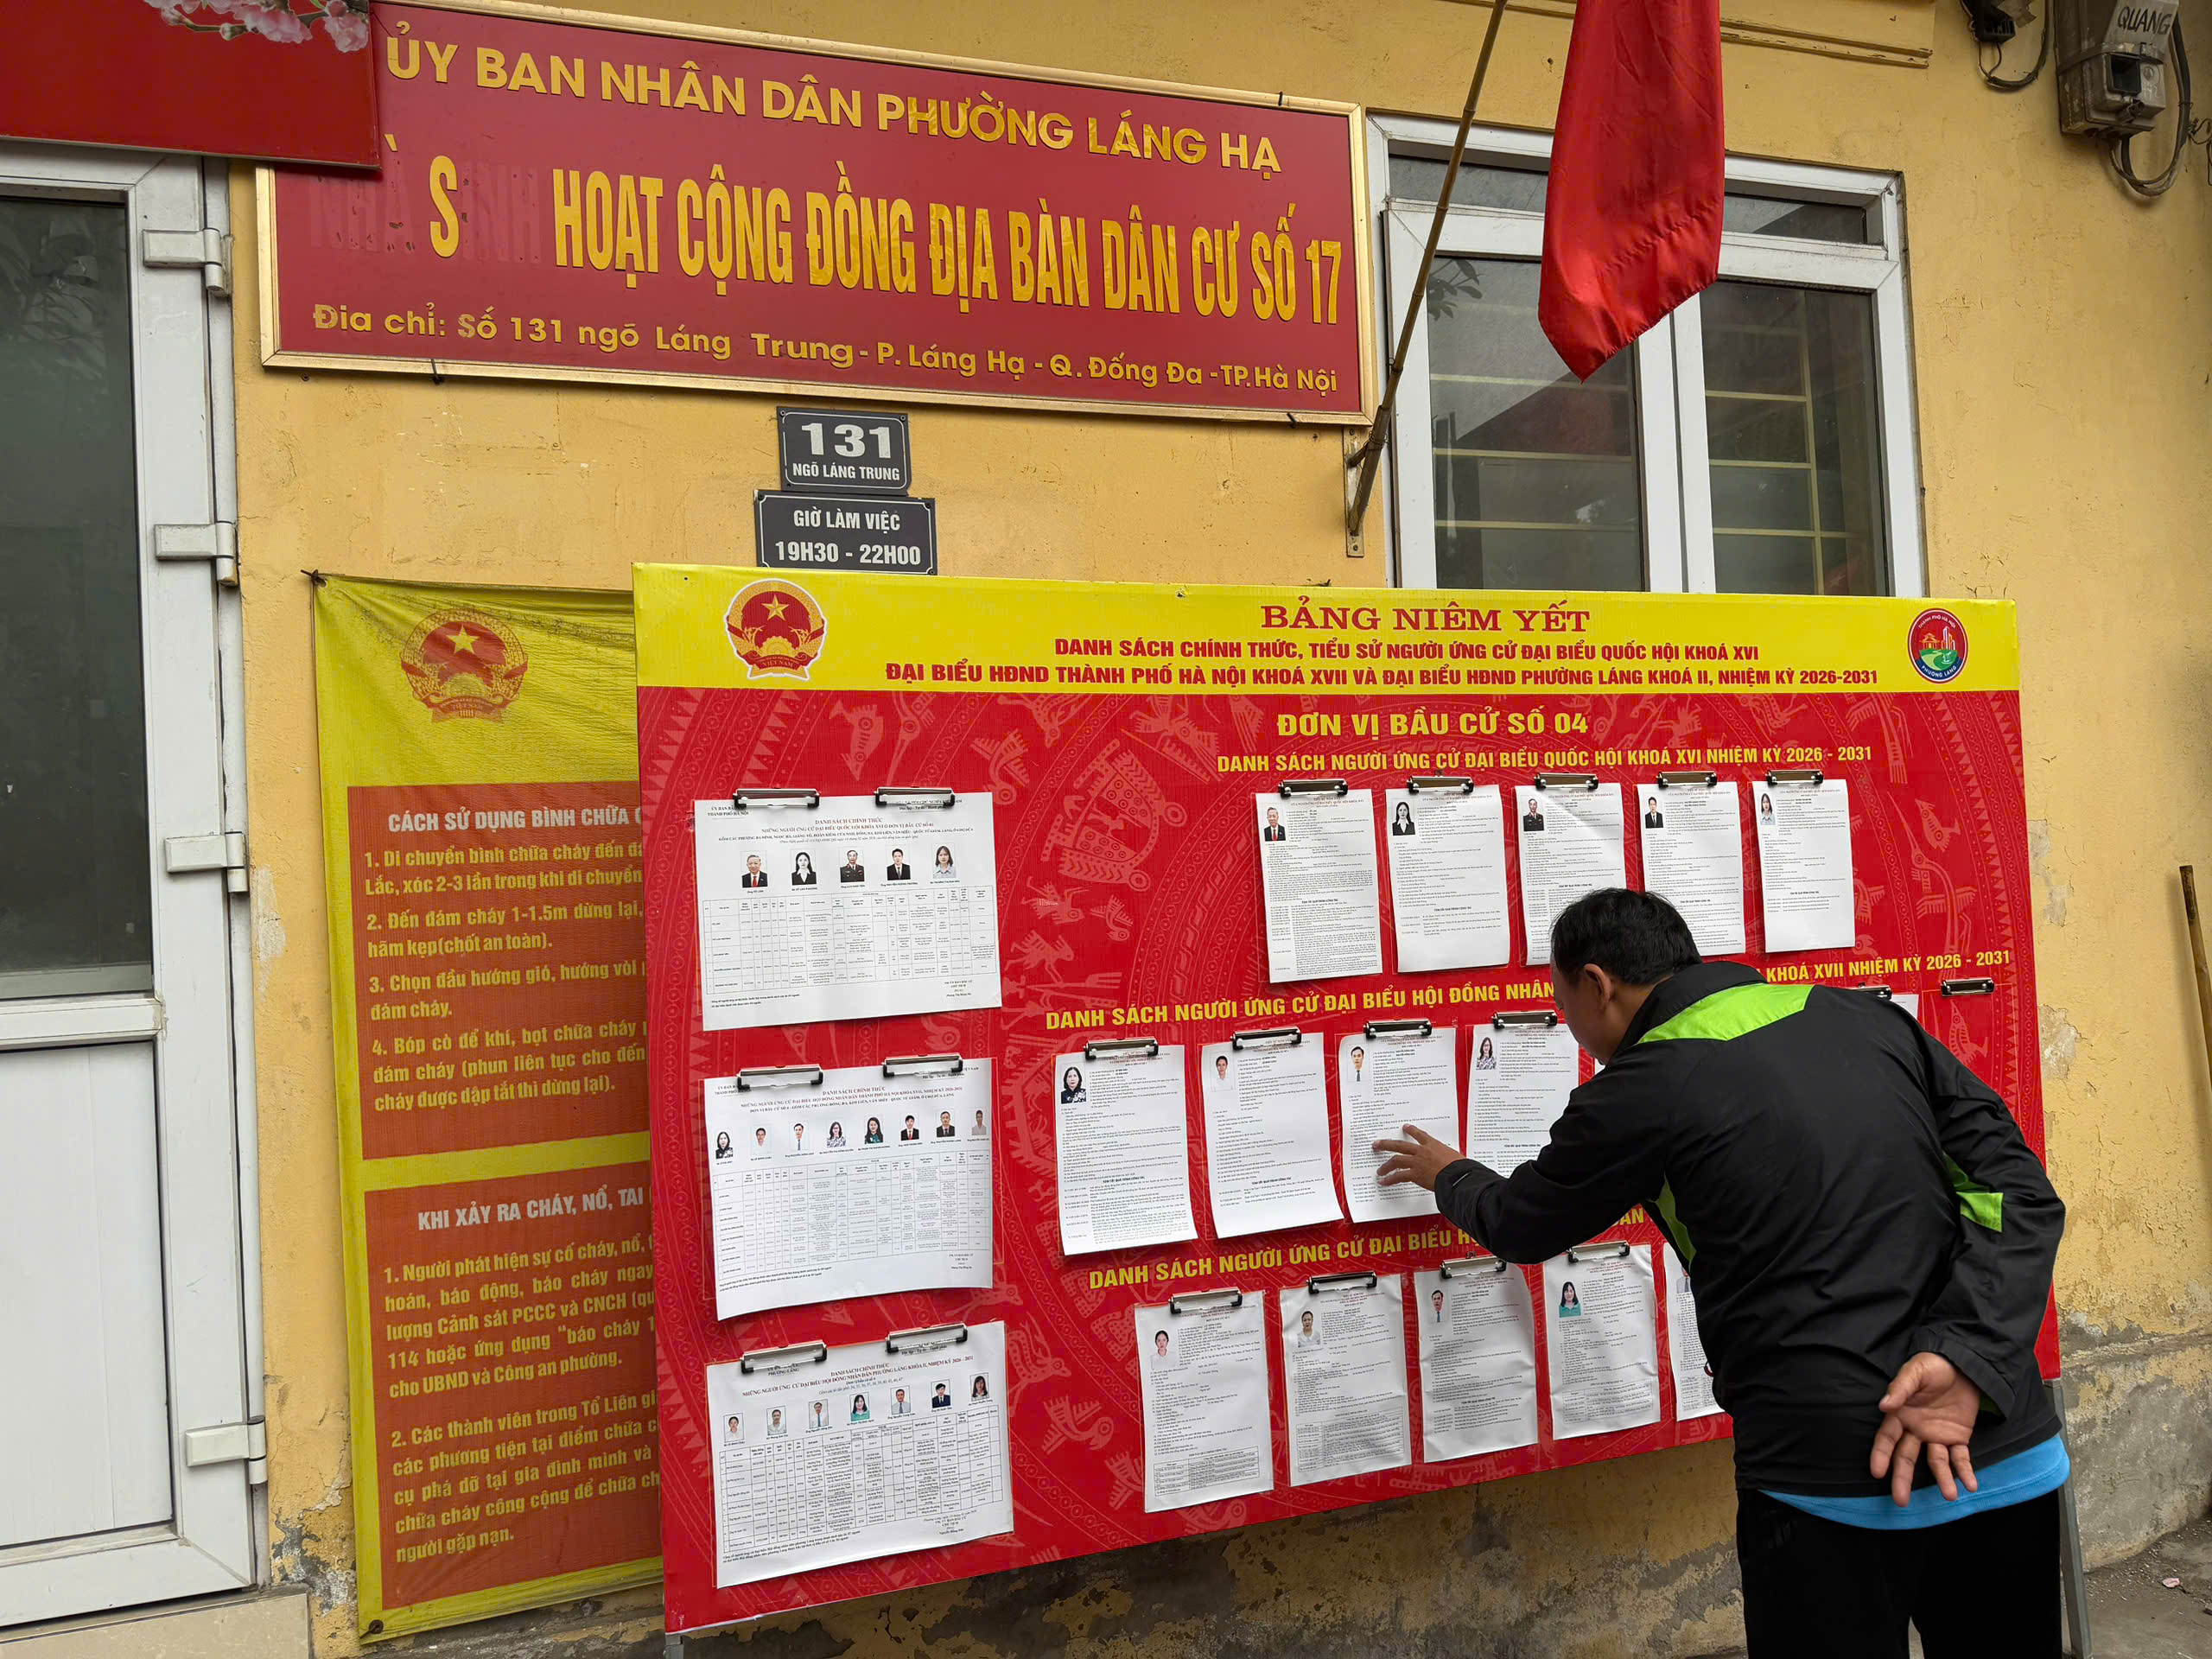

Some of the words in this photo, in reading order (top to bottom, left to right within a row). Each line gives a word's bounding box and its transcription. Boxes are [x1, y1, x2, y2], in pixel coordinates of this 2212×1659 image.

[2118, 6, 2172, 35] QUANG
[386, 21, 458, 83] ỦY
[477, 48, 585, 99] BAN
[601, 60, 746, 116] NHÂN
[762, 73, 861, 128] DÂN
[878, 91, 1074, 149] PHƯỜNG
[1088, 110, 1207, 165] LÁNG
[1221, 133, 1281, 181] HẠ
[552, 168, 664, 289] HOẠT
[677, 164, 793, 296] CỘNG
[806, 161, 916, 294] ĐỒNG
[929, 203, 998, 314] ĐỊA
[1008, 198, 1090, 308] BÀN
[1101, 205, 1180, 315] DÂN
[1191, 220, 1240, 317] CƯ
[1250, 203, 1296, 321] SỐ
[1305, 240, 1342, 324] 17
[385, 302, 446, 336] chỉ:
[458, 306, 499, 340] Số
[511, 317, 562, 344] 131
[579, 323, 640, 354] ngõ
[656, 324, 731, 359] Láng
[876, 342, 900, 365] P.
[908, 344, 976, 377] Láng
[988, 351, 1025, 381] Hạ
[1049, 354, 1081, 379] Q.
[1088, 352, 1157, 387] Đống
[1166, 362, 1203, 385] Đa
[1297, 367, 1337, 395] Nội
[802, 423, 892, 459] 131
[792, 461, 819, 476] NGÕ
[823, 462, 856, 479] LÁNG
[859, 467, 900, 480] TRUNG
[794, 506, 822, 528] GIỜ
[826, 508, 861, 529] LÀM
[865, 511, 900, 534] VIỆC
[776, 542, 839, 562] 19H30
[860, 544, 921, 565] 22H00
[1262, 595, 1382, 630] BẢNG
[1393, 601, 1502, 632] NIÊM
[1513, 599, 1590, 632] YẾT
[1055, 639, 1113, 656] DANH
[1119, 637, 1173, 658] SÁCH
[1179, 639, 1242, 658] CHÍNH
[1248, 639, 1303, 660] THỨC,
[1309, 637, 1350, 659] TIỂU
[1357, 639, 1382, 659] SỬ
[1387, 639, 1444, 659] NGƯỜI
[1449, 639, 1486, 659] ỨNG
[1492, 639, 1517, 659] CỬ
[1522, 644, 1550, 663] ĐẠI
[1557, 639, 1597, 661] BIỂU
[1601, 640, 1647, 662] QUỐC
[1651, 642, 1681, 664] HỘI
[1684, 642, 1728, 661] KHOÁ
[1733, 645, 1759, 661] XVI
[886, 663, 924, 683] ĐẠI
[931, 658, 983, 682] BIỂU
[990, 664, 1049, 683] HĐND
[1056, 664, 1125, 684] THÀNH
[1132, 663, 1173, 684] PHỐ
[1179, 665, 1206, 684] HÀ
[1211, 665, 1246, 688] NỘI
[1253, 665, 1305, 684] KHOÁ
[1311, 669, 1346, 684] XVII
[1353, 665, 1377, 684] VÀ
[1382, 669, 1414, 688] ĐẠI
[1420, 664, 1461, 684] BIỂU
[1467, 669, 1516, 684] HĐND
[1522, 668, 1595, 685] PHƯỜNG
[1599, 667, 1643, 685] LÁNG
[1648, 667, 1694, 685] KHOÁ
[1697, 670, 1713, 688] II,
[1718, 667, 1770, 688] NHIỆM
[1776, 668, 1795, 685] KỲ
[1800, 670, 1878, 685] 2026-2031
[1277, 711, 1340, 736] ĐƠN
[1351, 713, 1379, 741] VỊ
[1390, 707, 1448, 735] BẦU
[1459, 705, 1500, 735] CỬ
[1508, 704, 1545, 735] SỐ
[1554, 712, 1588, 734] 04
[1217, 753, 1269, 772] DANH
[1275, 753, 1325, 771] SÁCH
[1332, 752, 1388, 771] NGƯỜI
[1393, 750, 1430, 770] ỨNG
[1436, 747, 1460, 769] CỬ
[1465, 752, 1494, 772] ĐẠI
[1500, 746, 1537, 768] BIỂU
[1543, 744, 1589, 767] QUỐC
[1595, 747, 1623, 770] HỘI
[1627, 745, 1671, 766] KHOÁ
[1676, 749, 1701, 765] XVI
[1707, 746, 1758, 767] NHIỆM
[1762, 744, 1782, 764] KỲ
[1786, 747, 1822, 763] 2026
[1839, 746, 1872, 762] 2031
[389, 810, 439, 832] CÁCH
[444, 806, 470, 830] SỬ
[476, 811, 525, 833] DỤNG
[531, 806, 575, 828] BÌNH
[582, 804, 629, 826] CHỮA
[1046, 1008, 1106, 1031] DANH
[1111, 1002, 1168, 1027] SÁCH
[1174, 999, 1237, 1022] NGƯỜI
[1243, 993, 1285, 1018] ỨNG
[1292, 988, 1320, 1014] CỬ
[1324, 993, 1357, 1014] ĐẠI
[1362, 983, 1406, 1008] BIỂU
[1412, 985, 1444, 1009] HỘI
[1449, 980, 1500, 1004] ĐỒNG
[1506, 979, 1554, 1000] NHÂN
[1766, 962, 1809, 982] KHOÁ
[1815, 961, 1844, 979] XVII
[1849, 957, 1898, 979] NHIỆM
[1904, 954, 1922, 971] KỲ
[1927, 954, 1961, 971] 2026
[1976, 950, 2011, 966] 2031
[418, 1210, 449, 1230] KHI
[455, 1201, 491, 1227] XẢY
[497, 1204, 521, 1222] RA
[527, 1194, 576, 1218] CHÁY,
[583, 1186, 613, 1211] NỔ,
[619, 1187, 644, 1206] TAI
[1089, 1265, 1150, 1290] DANH
[1155, 1257, 1212, 1283] SÁCH
[1218, 1249, 1284, 1276] NGƯỜI
[1289, 1243, 1331, 1268] ỨNG
[1337, 1233, 1363, 1262] CỬ
[1370, 1236, 1402, 1256] ĐẠI
[1408, 1224, 1452, 1250] BIỂU
[390, 1380, 419, 1398] cho
[423, 1371, 468, 1394] UBND
[472, 1368, 491, 1386] và
[493, 1364, 534, 1382] Công
[537, 1363, 557, 1376] an
[561, 1351, 622, 1374] phường.
